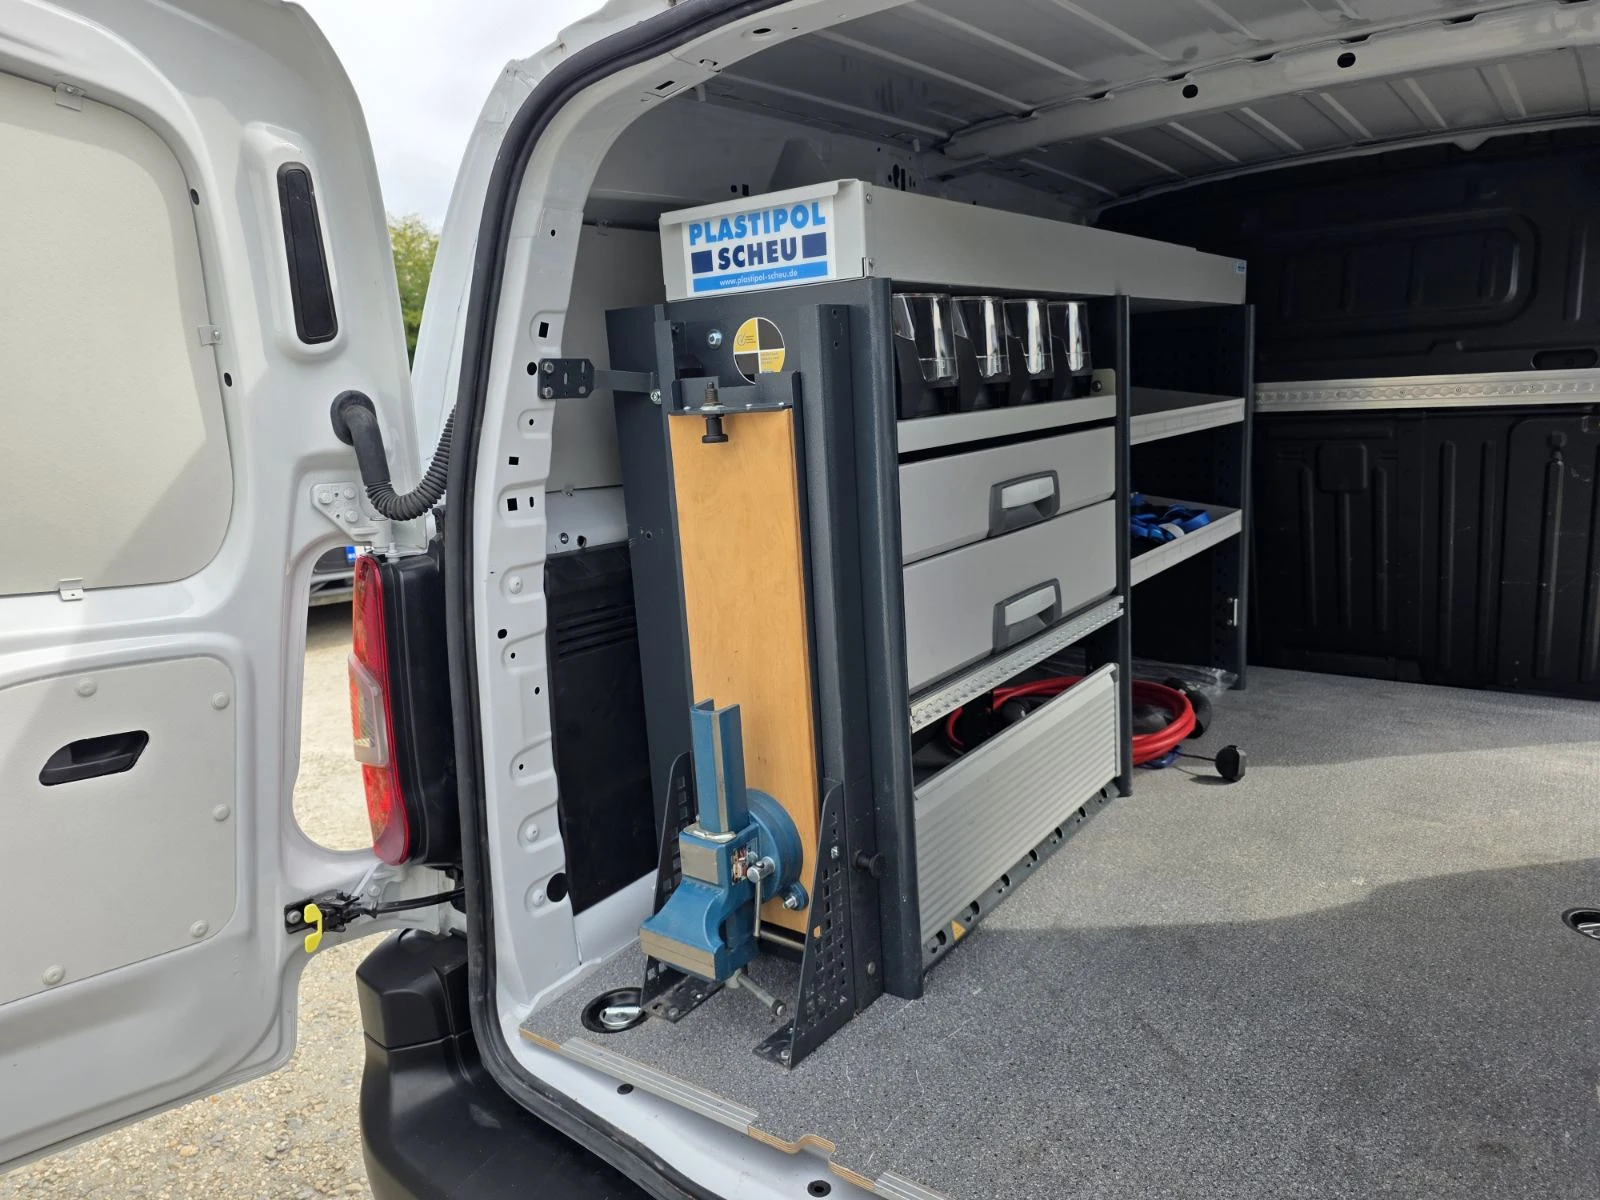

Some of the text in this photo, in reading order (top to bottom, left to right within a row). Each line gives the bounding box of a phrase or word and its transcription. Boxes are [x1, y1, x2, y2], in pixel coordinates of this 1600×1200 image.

[689, 202, 826, 246] PLASTIPOL
[718, 237, 797, 270] SCHEU
[720, 269, 798, 286] www.plastipol-scheu.de
